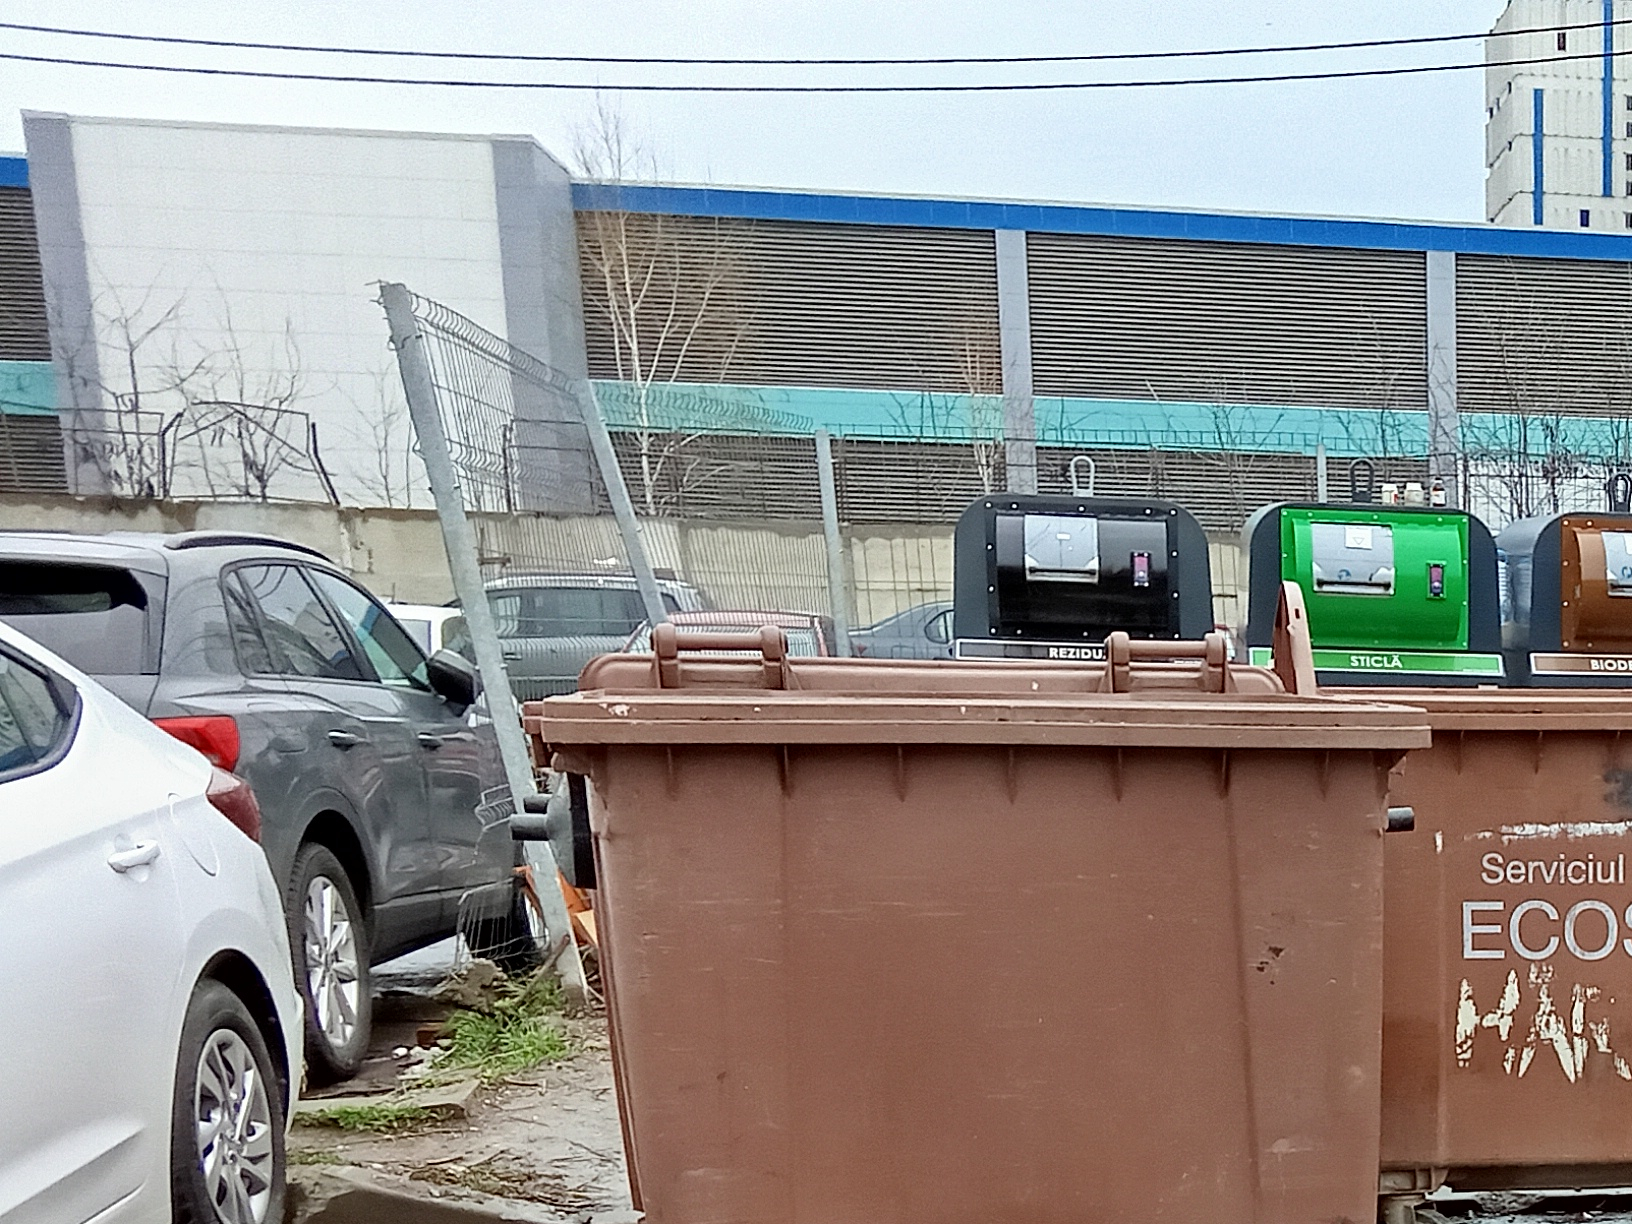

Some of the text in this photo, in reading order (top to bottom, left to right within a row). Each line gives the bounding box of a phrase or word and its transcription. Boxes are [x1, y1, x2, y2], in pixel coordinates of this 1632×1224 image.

[1049, 647, 1107, 660] REZIDU
[1350, 653, 1403, 668] STICLĂ
[1480, 853, 1624, 884] Serviciul
